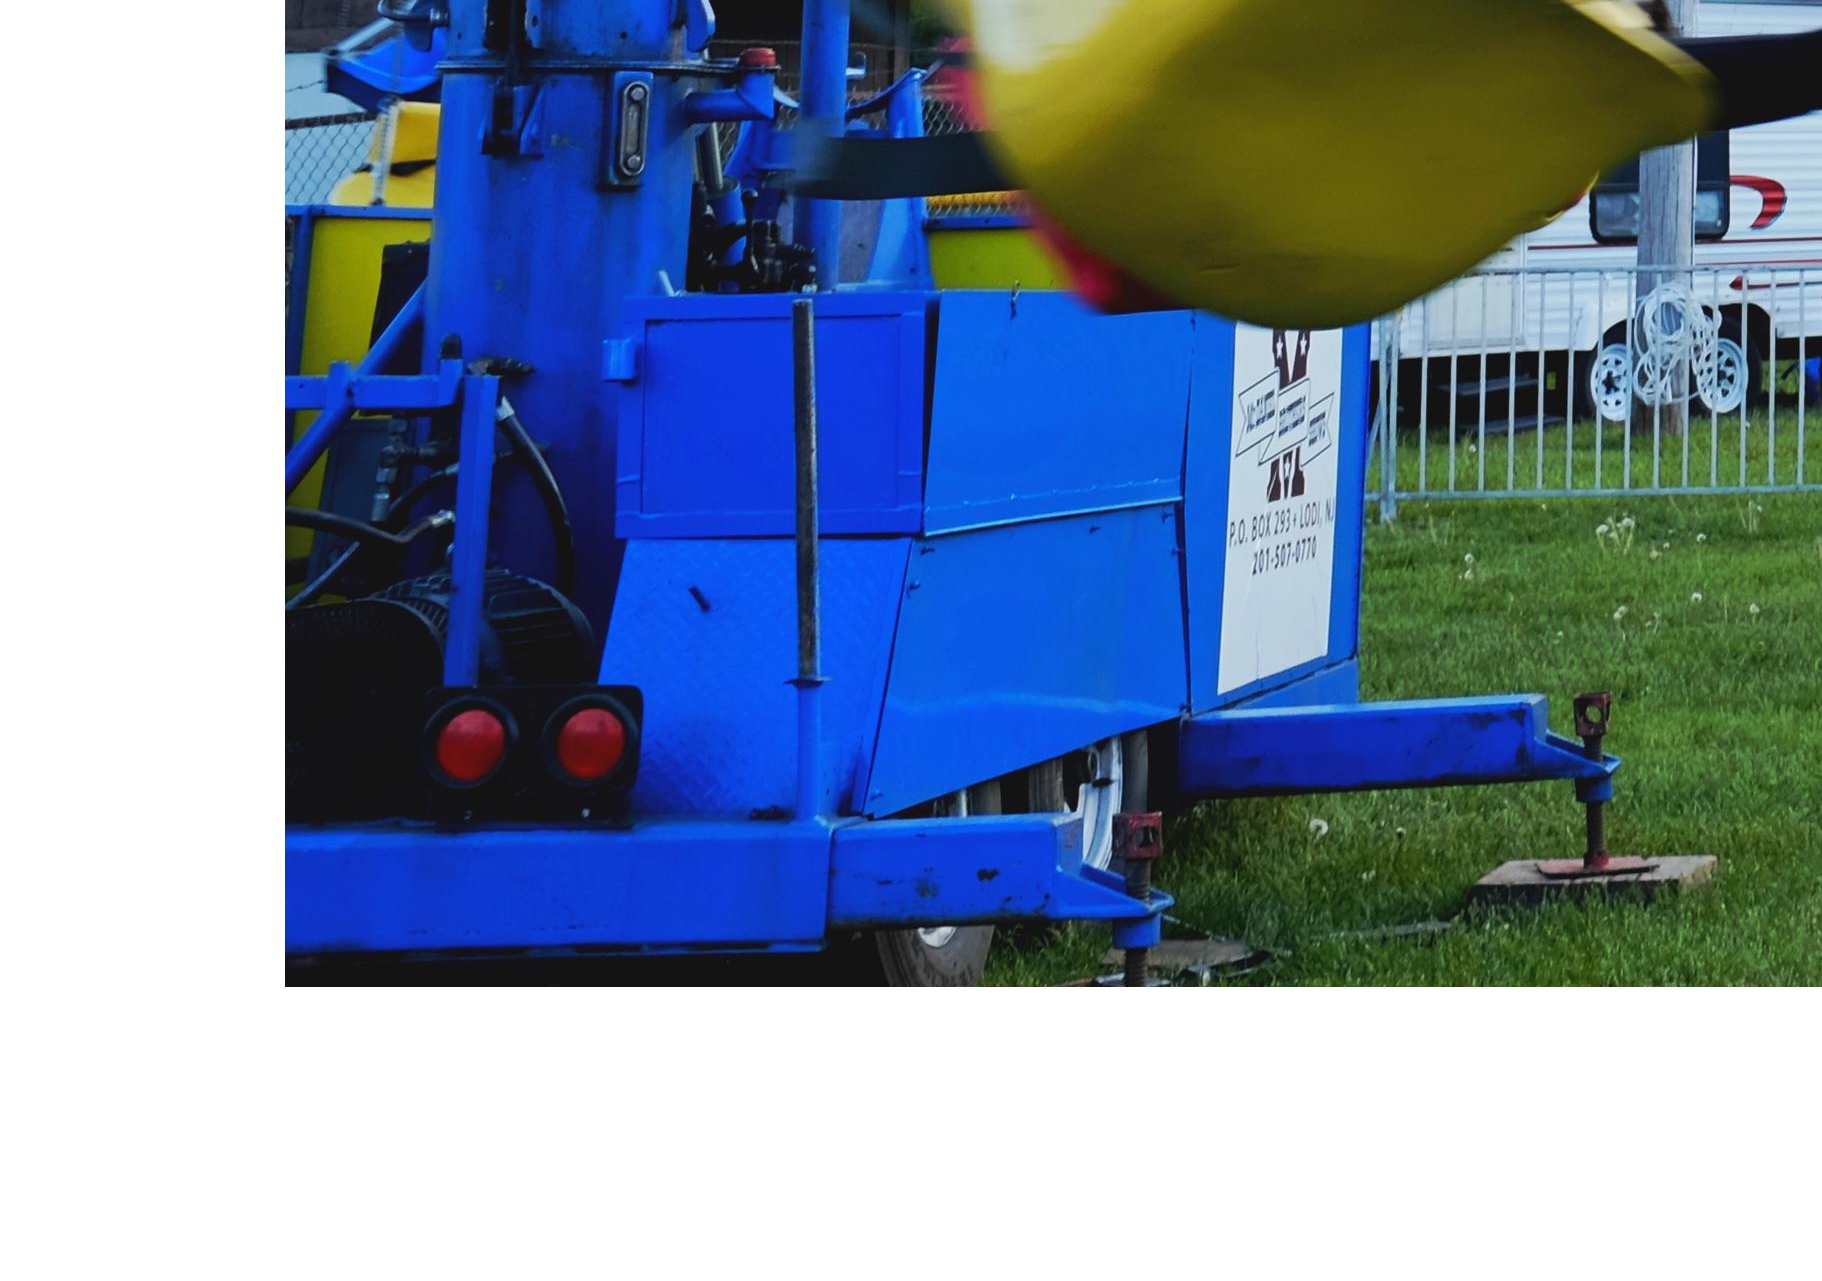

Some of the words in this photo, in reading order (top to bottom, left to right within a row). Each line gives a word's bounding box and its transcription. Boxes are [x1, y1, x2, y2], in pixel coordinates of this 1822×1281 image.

[1251, 512, 1271, 542] BOX
[1274, 507, 1291, 535] 293
[1252, 535, 1317, 576] 201-507-0770
